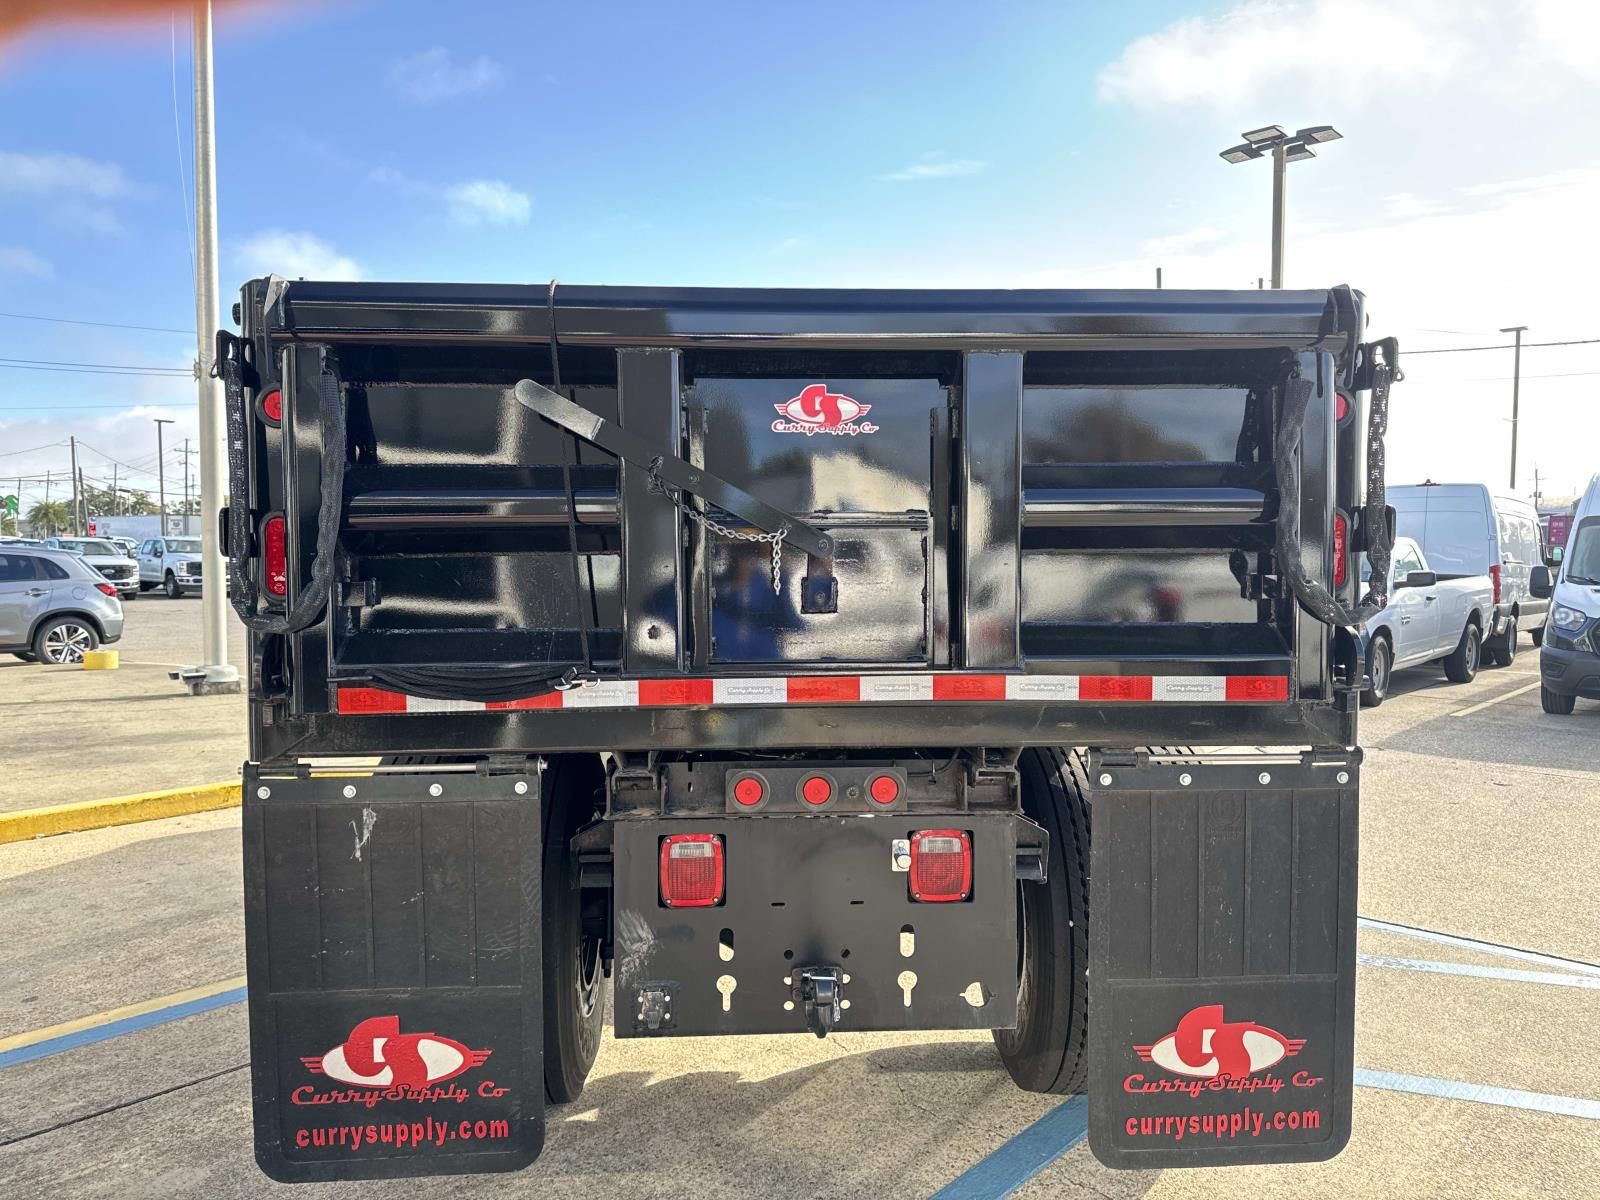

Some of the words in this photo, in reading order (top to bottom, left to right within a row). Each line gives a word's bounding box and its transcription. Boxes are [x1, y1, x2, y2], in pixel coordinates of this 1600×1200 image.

[771, 419, 816, 436] Curry
[816, 422, 859, 436] Supply
[860, 422, 879, 433] Co
[291, 1085, 383, 1108] Curry
[382, 1083, 470, 1103] Supply
[477, 1081, 511, 1097] Co
[1123, 1073, 1205, 1098] Curry
[1205, 1073, 1285, 1093] Supply
[1292, 1071, 1324, 1087] Co
[296, 1116, 509, 1150] currysupply.com
[1126, 1107, 1321, 1140] currysupply.com
